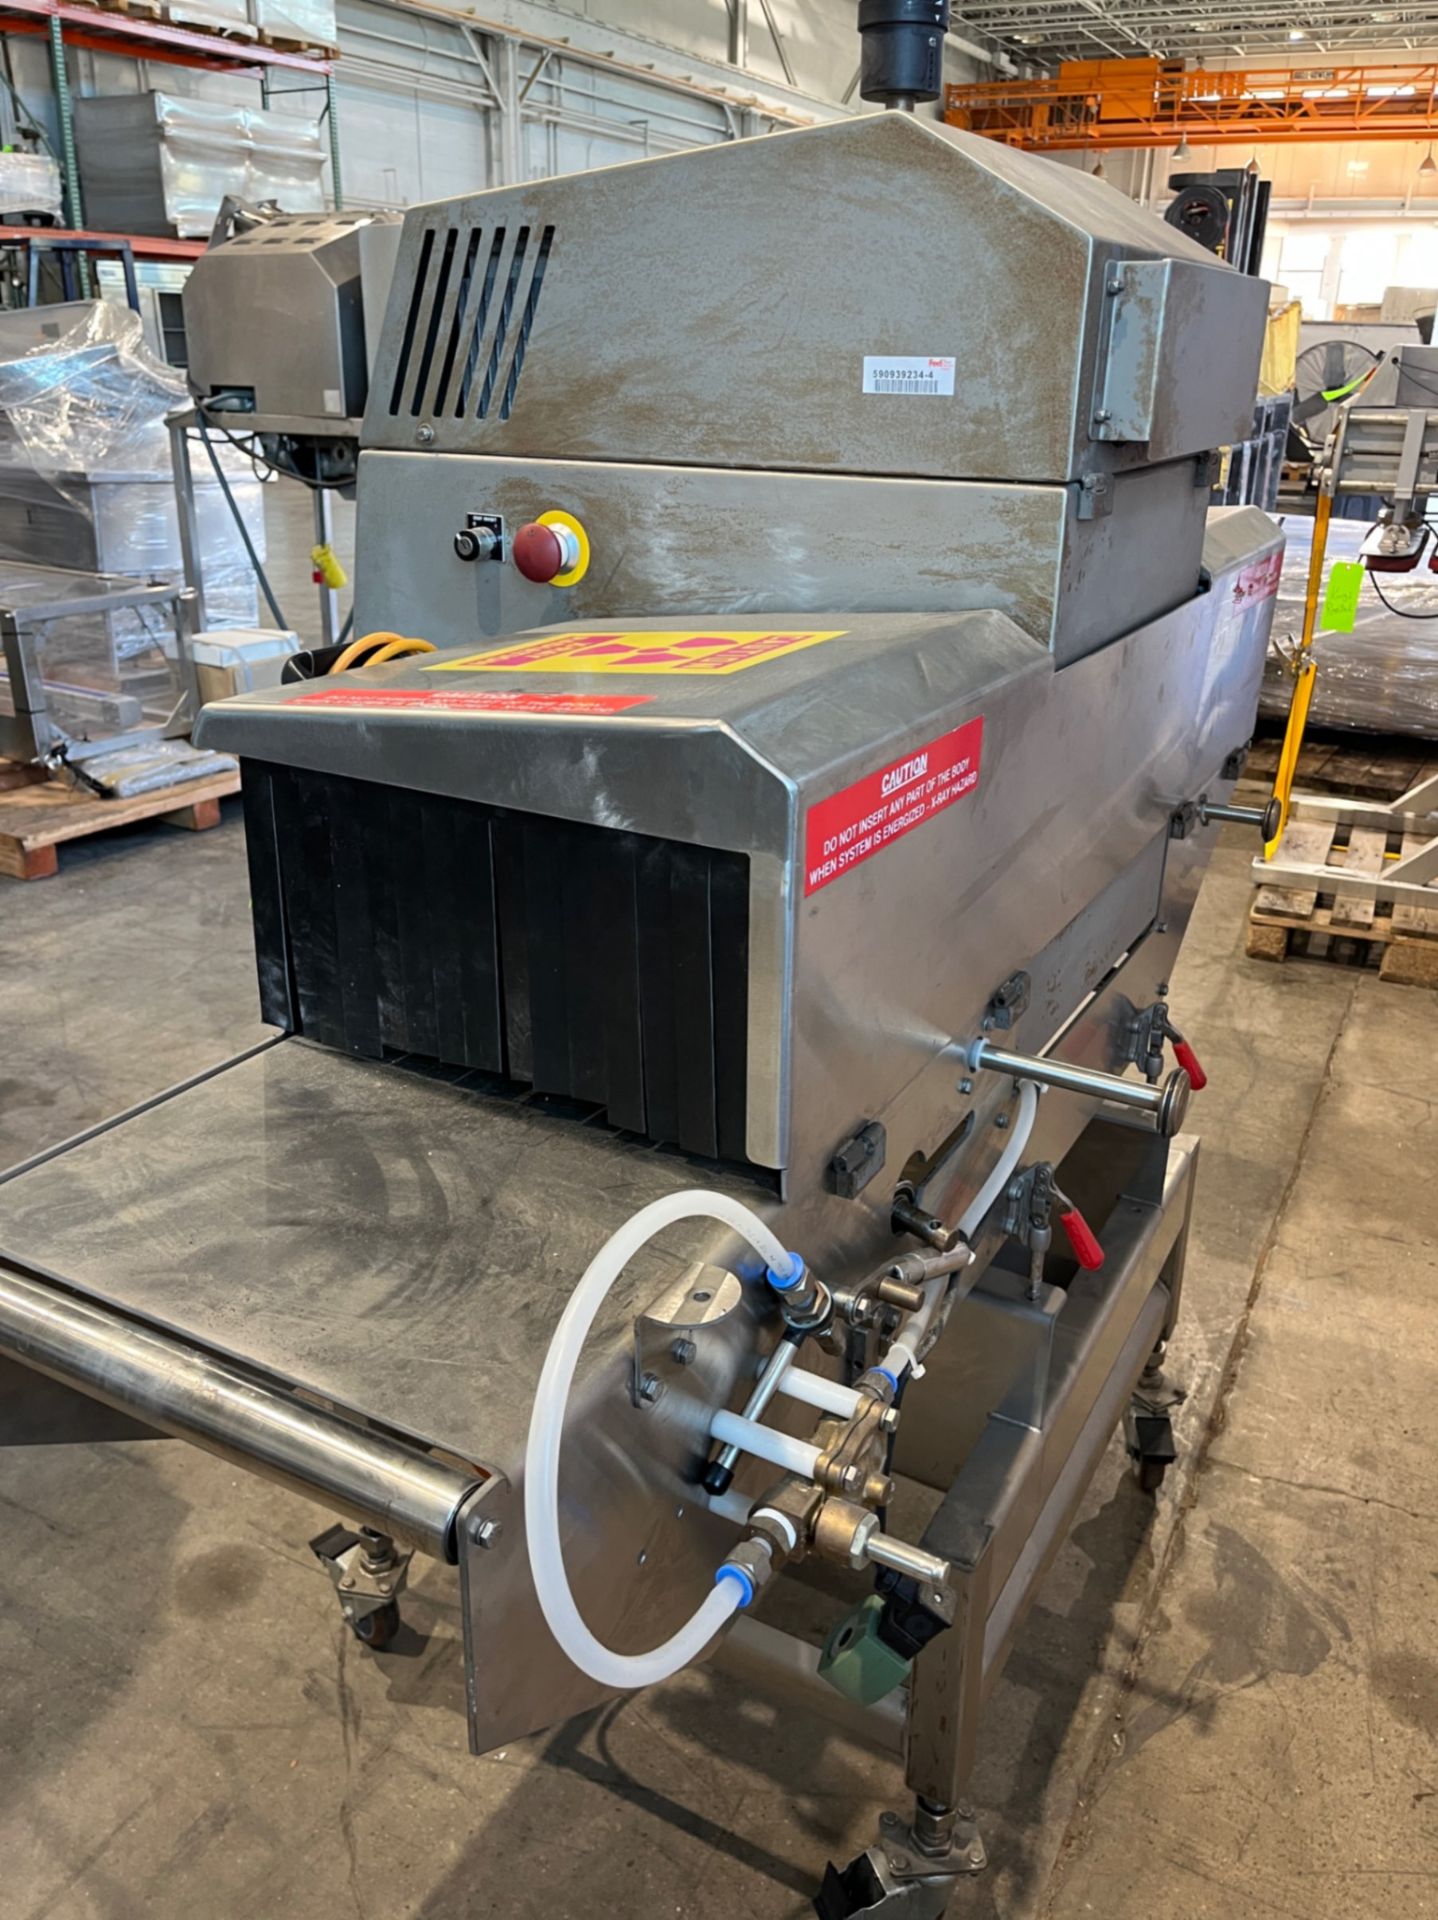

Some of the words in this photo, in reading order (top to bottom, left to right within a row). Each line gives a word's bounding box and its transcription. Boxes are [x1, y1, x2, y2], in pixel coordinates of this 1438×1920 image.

[873, 369, 934, 379] 590939234-4
[823, 836, 838, 856] DO
[839, 823, 857, 847] NOT
[859, 805, 889, 834] INSERT
[889, 795, 906, 816] ANY
[906, 783, 926, 806] PART
[926, 776, 937, 793] OF
[937, 767, 951, 786] THE
[951, 756, 970, 778] BODY
[881, 752, 928, 796] CAUTION
[809, 857, 837, 886] WHEN
[839, 835, 872, 868] SYSTEM
[874, 829, 883, 846] IS
[883, 803, 925, 840] ENERGIZED
[931, 786, 951, 808] X-RAY
[951, 770, 977, 797] HAZARD
